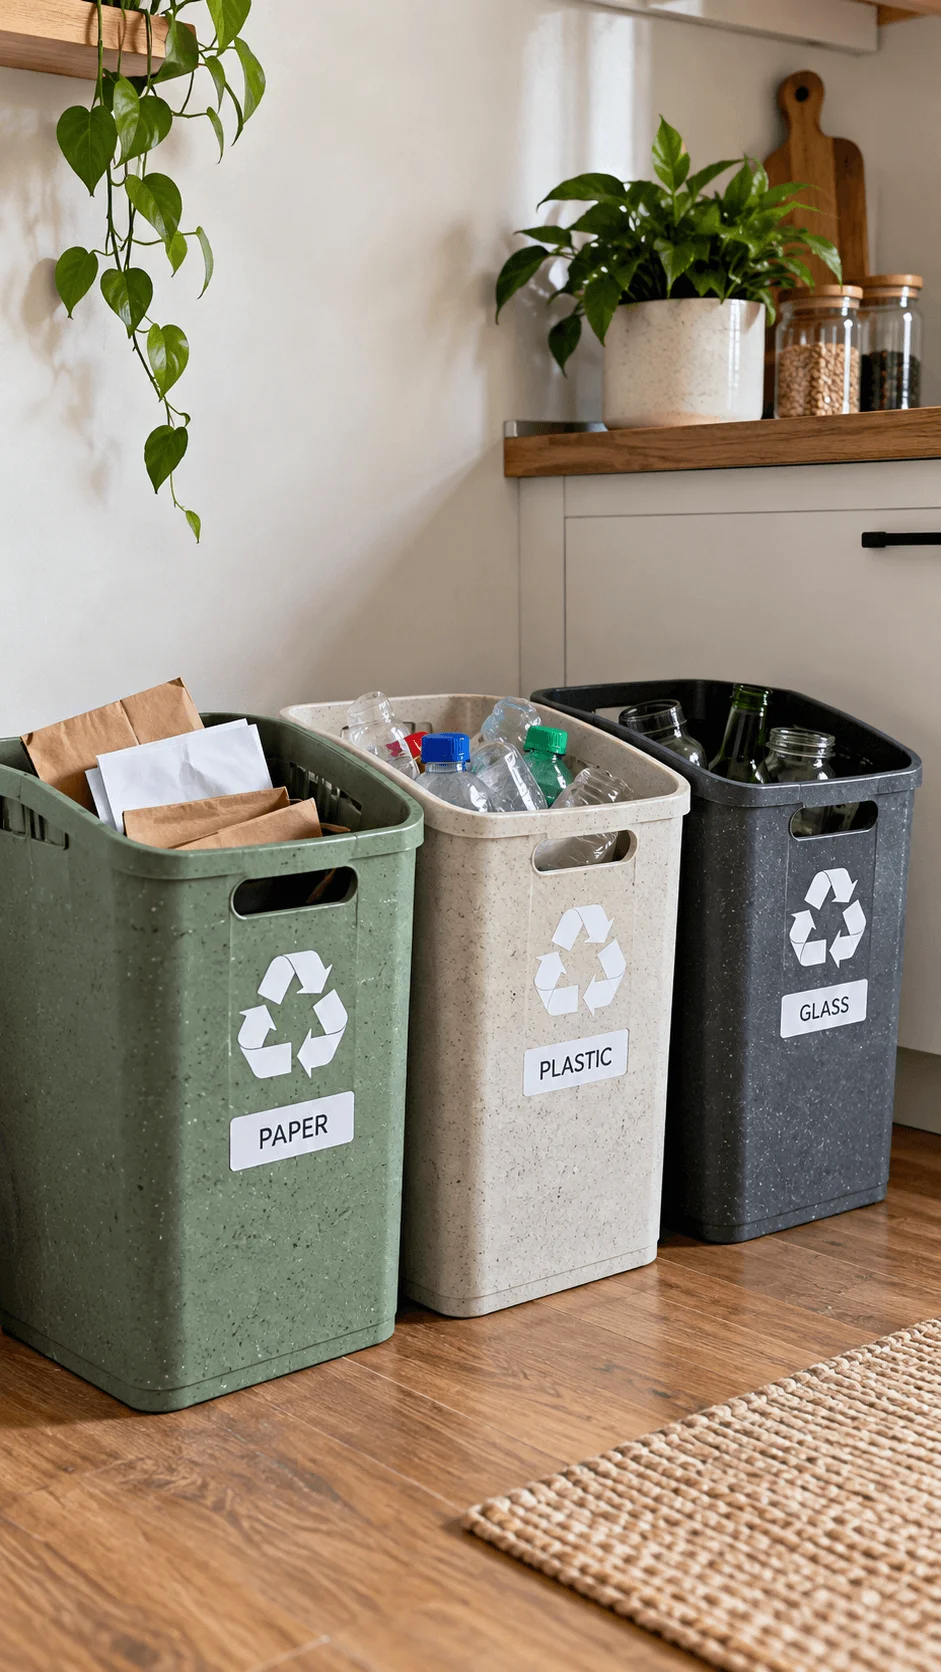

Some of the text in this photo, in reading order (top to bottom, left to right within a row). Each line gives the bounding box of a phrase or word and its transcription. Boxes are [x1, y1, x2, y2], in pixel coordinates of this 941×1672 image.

[799, 995, 850, 1022] GLASS
[539, 1046, 613, 1081] PLASTIC
[259, 1113, 328, 1150] PAPER
